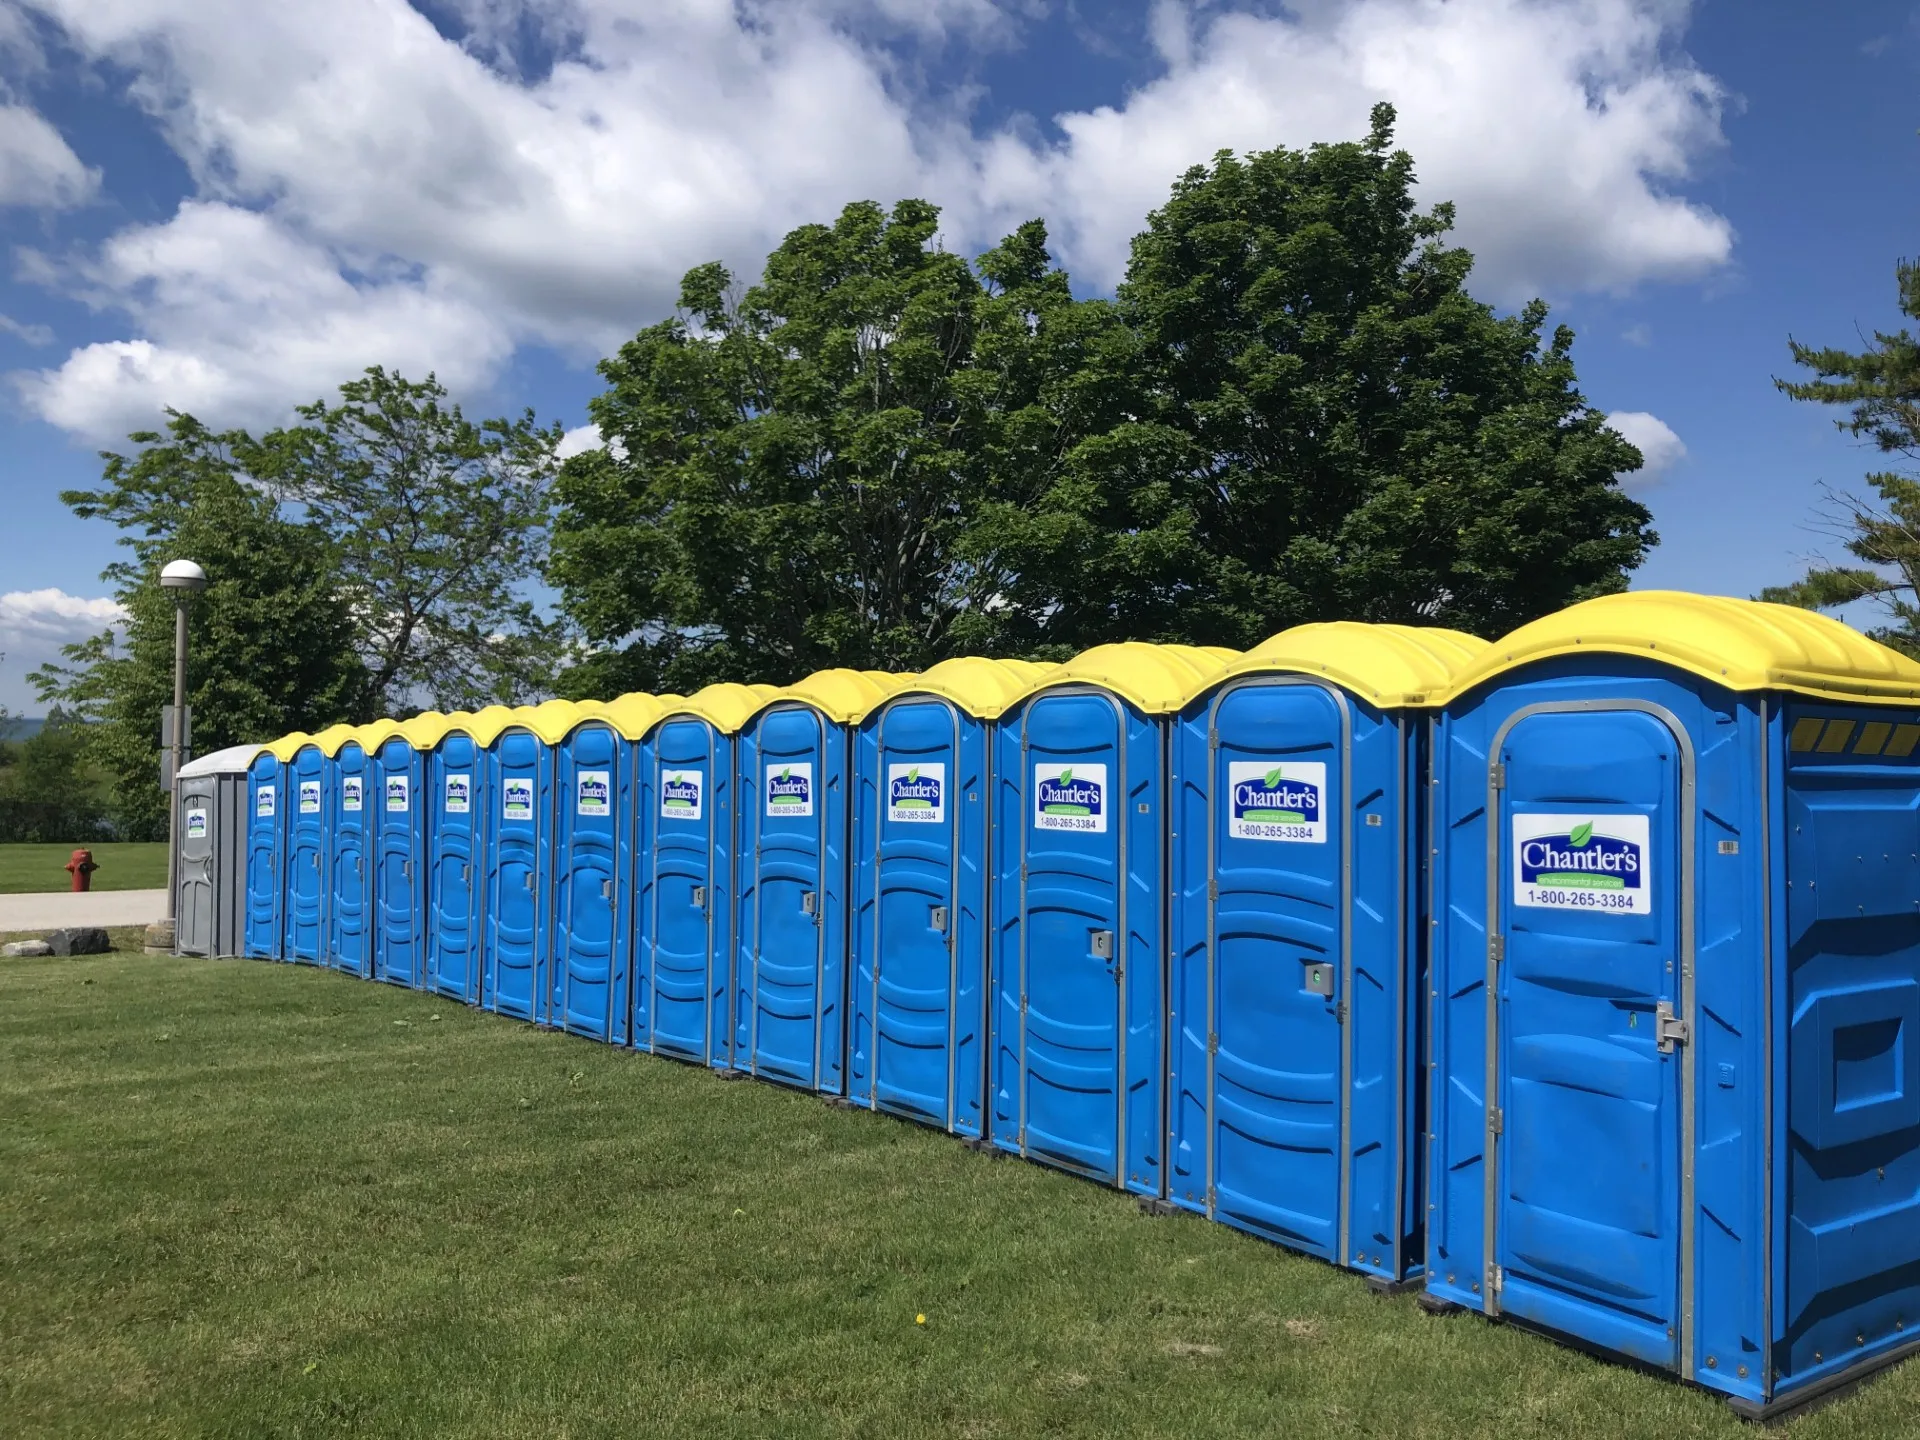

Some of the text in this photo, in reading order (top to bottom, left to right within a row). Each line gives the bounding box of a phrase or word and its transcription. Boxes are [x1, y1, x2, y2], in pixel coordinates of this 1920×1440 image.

[664, 784, 698, 800] Chantler's
[770, 780, 808, 795] Chantler's
[892, 781, 939, 798] Chantler's
[1040, 783, 1100, 804] Chantler's
[1235, 784, 1317, 809] Chantler's
[893, 810, 936, 820] 1-800-265-3384
[1041, 817, 1096, 829] 1-800-265-3384
[1238, 824, 1313, 839] 1-800-265-3384
[1522, 842, 1638, 872] Chantler's
[1538, 876, 1622, 888] environmental services
[1528, 890, 1634, 909] 1-800-265-3384
